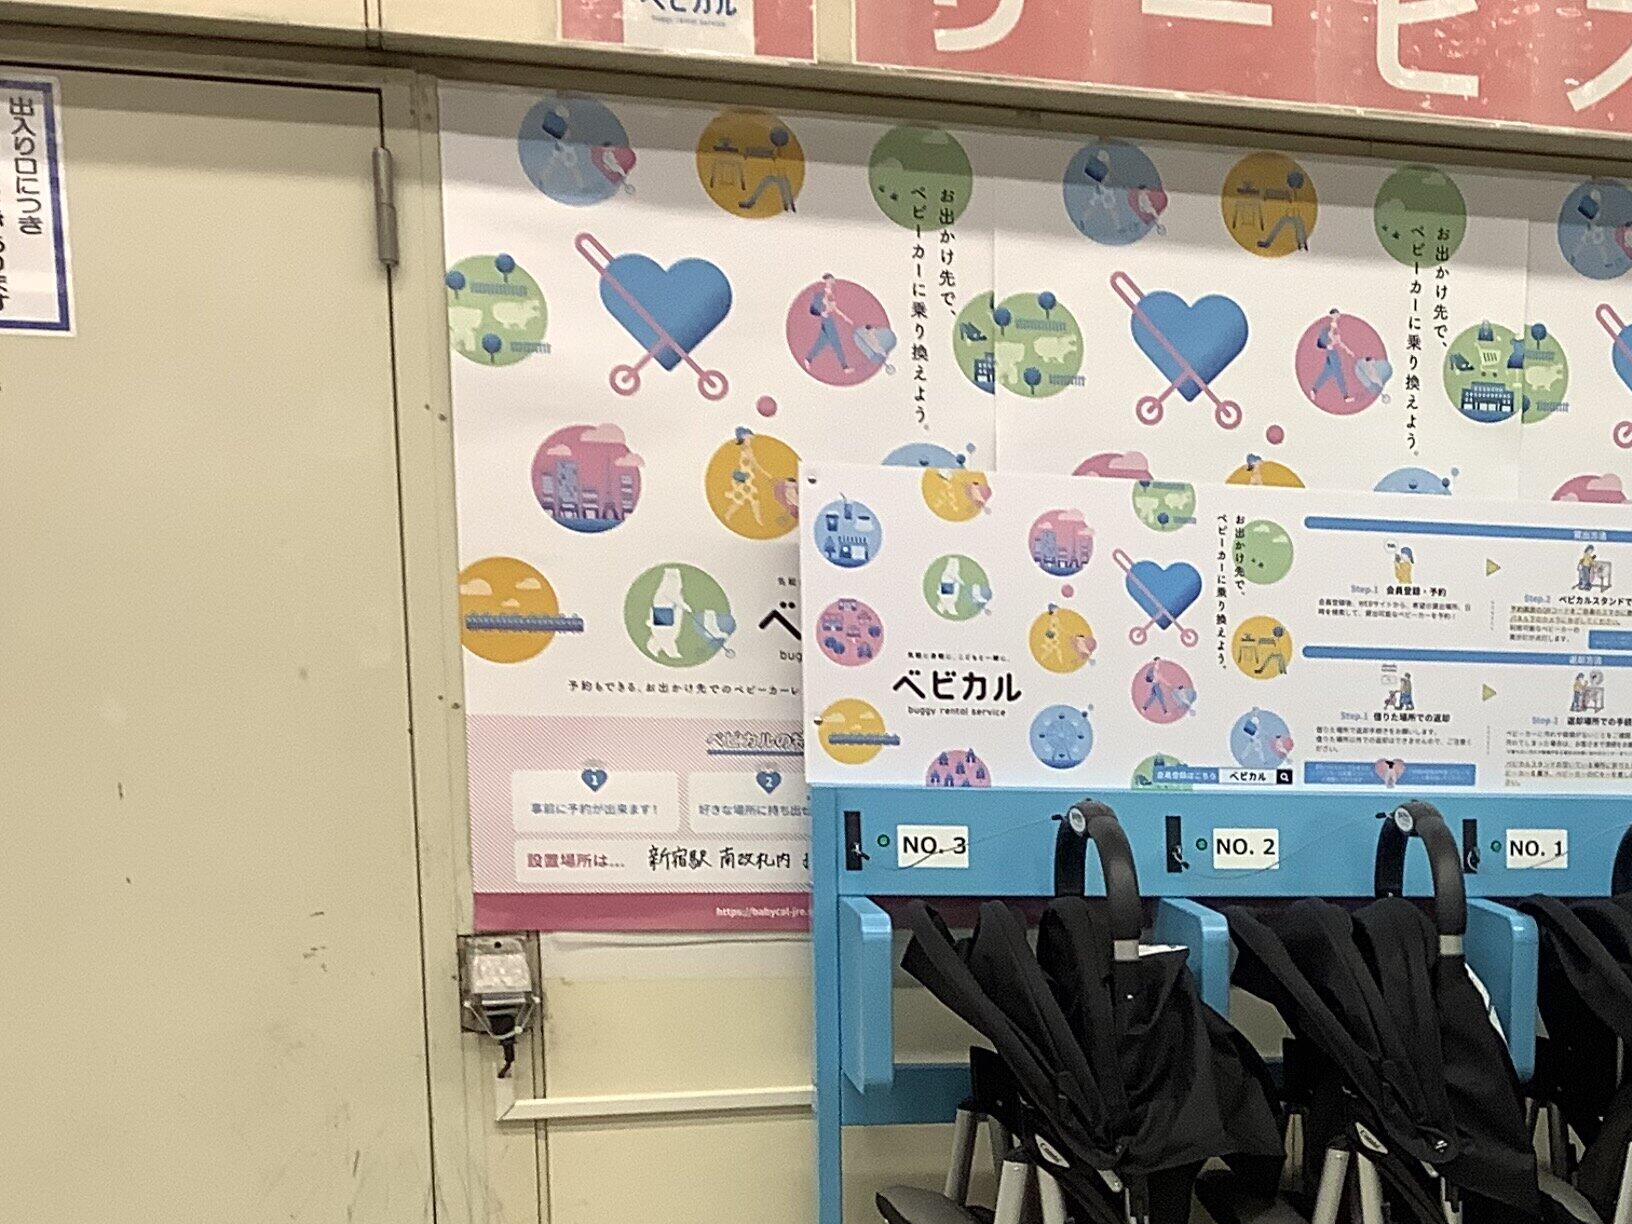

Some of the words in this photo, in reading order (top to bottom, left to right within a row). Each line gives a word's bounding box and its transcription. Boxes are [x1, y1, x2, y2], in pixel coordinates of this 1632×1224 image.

[10, 96, 43, 235] 出入り口につき
[939, 188, 957, 316] お出かけ先で、
[1433, 227, 1450, 348] お出かけ先で、
[910, 186, 930, 432] ベビーカーに乗り換えよう。
[1405, 226, 1425, 457] ベビーカーに乗り換えよう。
[893, 670, 1022, 702] ベビカル
[1230, 771, 1267, 782] ベビカル
[648, 845, 712, 872] 新宿駅
[719, 847, 791, 870] 南改札内
[903, 836, 944, 854] NO.
[953, 837, 966, 854] 3
[1216, 838, 1254, 855] NO.
[1263, 838, 1275, 855] 2
[1510, 840, 1545, 857] NO.
[1554, 840, 1562, 857] 1
